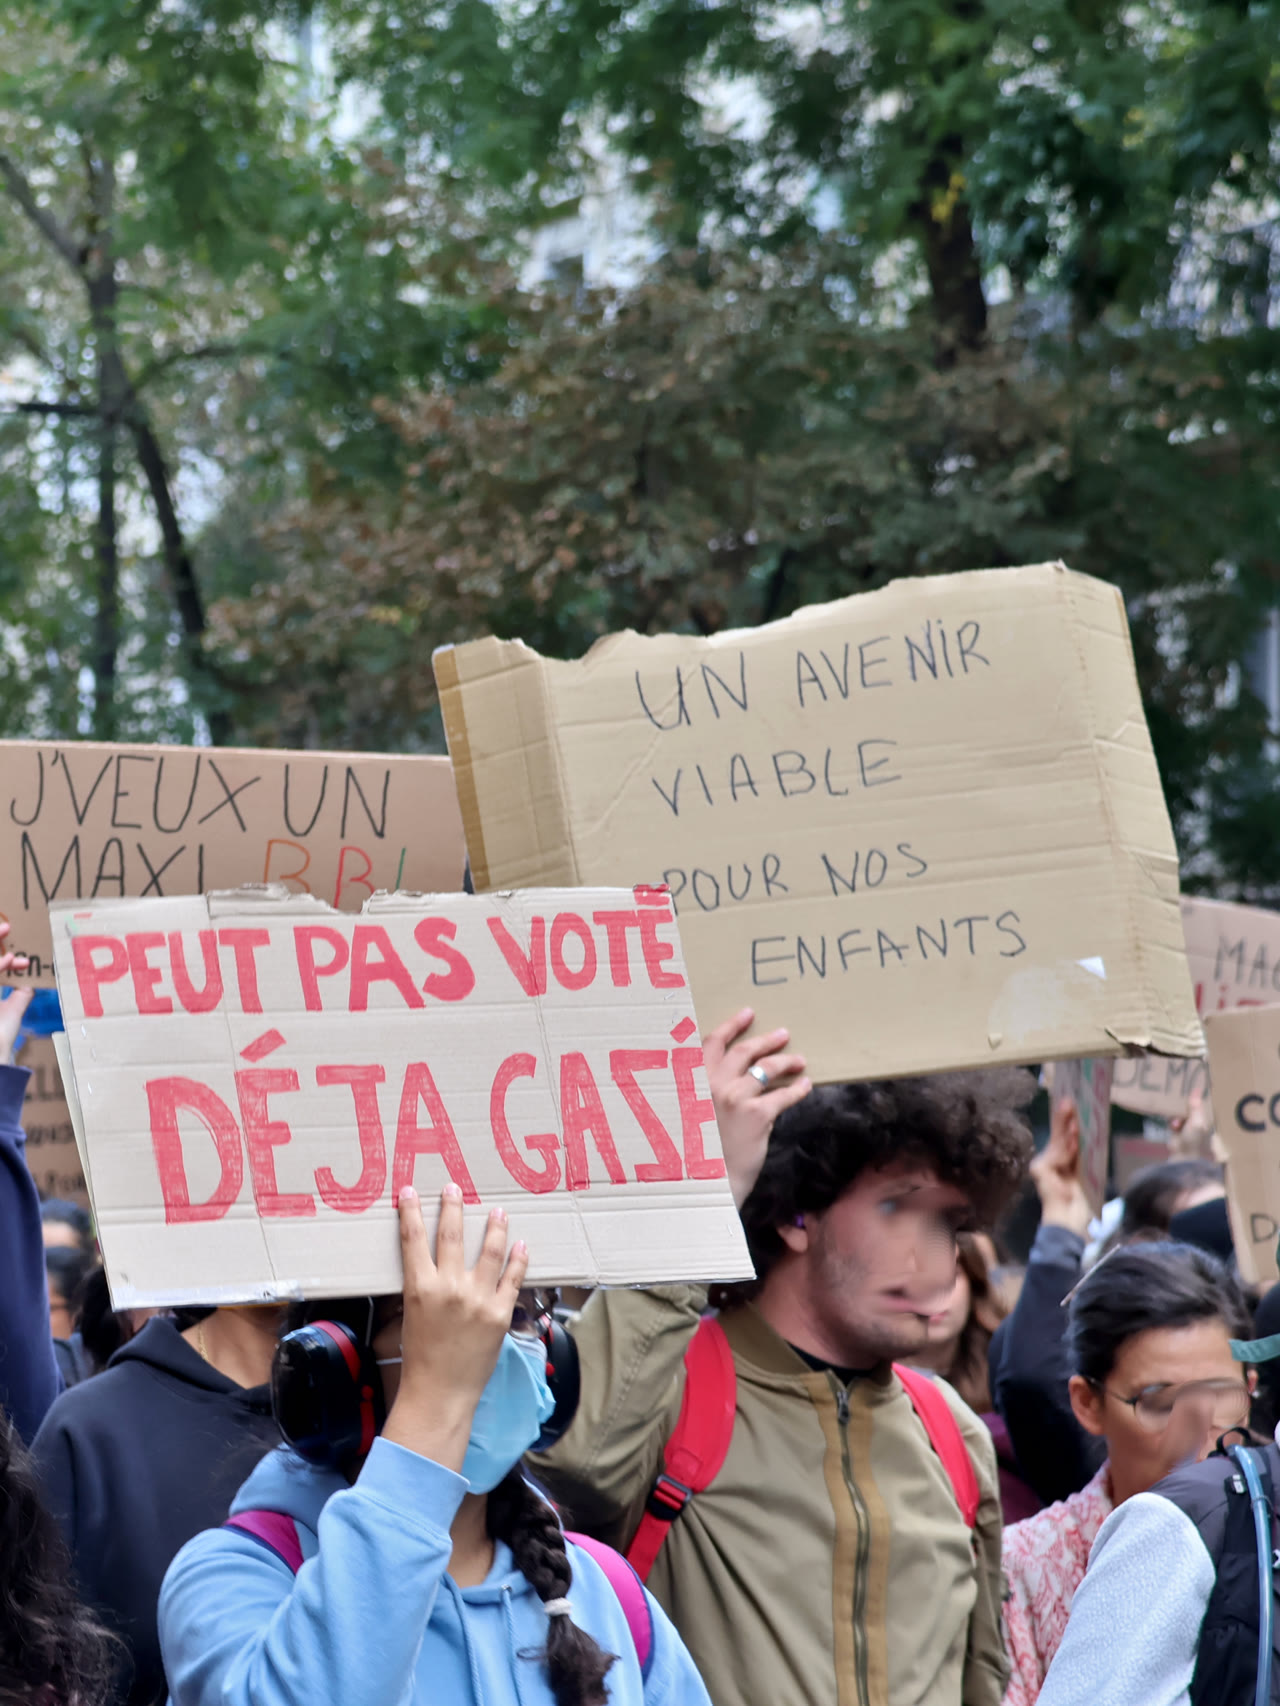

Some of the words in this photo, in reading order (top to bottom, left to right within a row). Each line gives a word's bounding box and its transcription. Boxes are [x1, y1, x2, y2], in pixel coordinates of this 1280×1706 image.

[635, 650, 749, 731] UN
[9, 748, 262, 834] J'VEUX
[283, 762, 391, 840] UN
[651, 739, 903, 817] VIABLE
[21, 830, 205, 910] MAXI
[662, 853, 790, 917] POUR
[821, 842, 929, 897] NOS
[72, 925, 271, 1019] PEUT
[293, 916, 477, 1012] PAS
[750, 910, 1028, 988] ENFANTS
[145, 1028, 482, 1225] DÉJA
